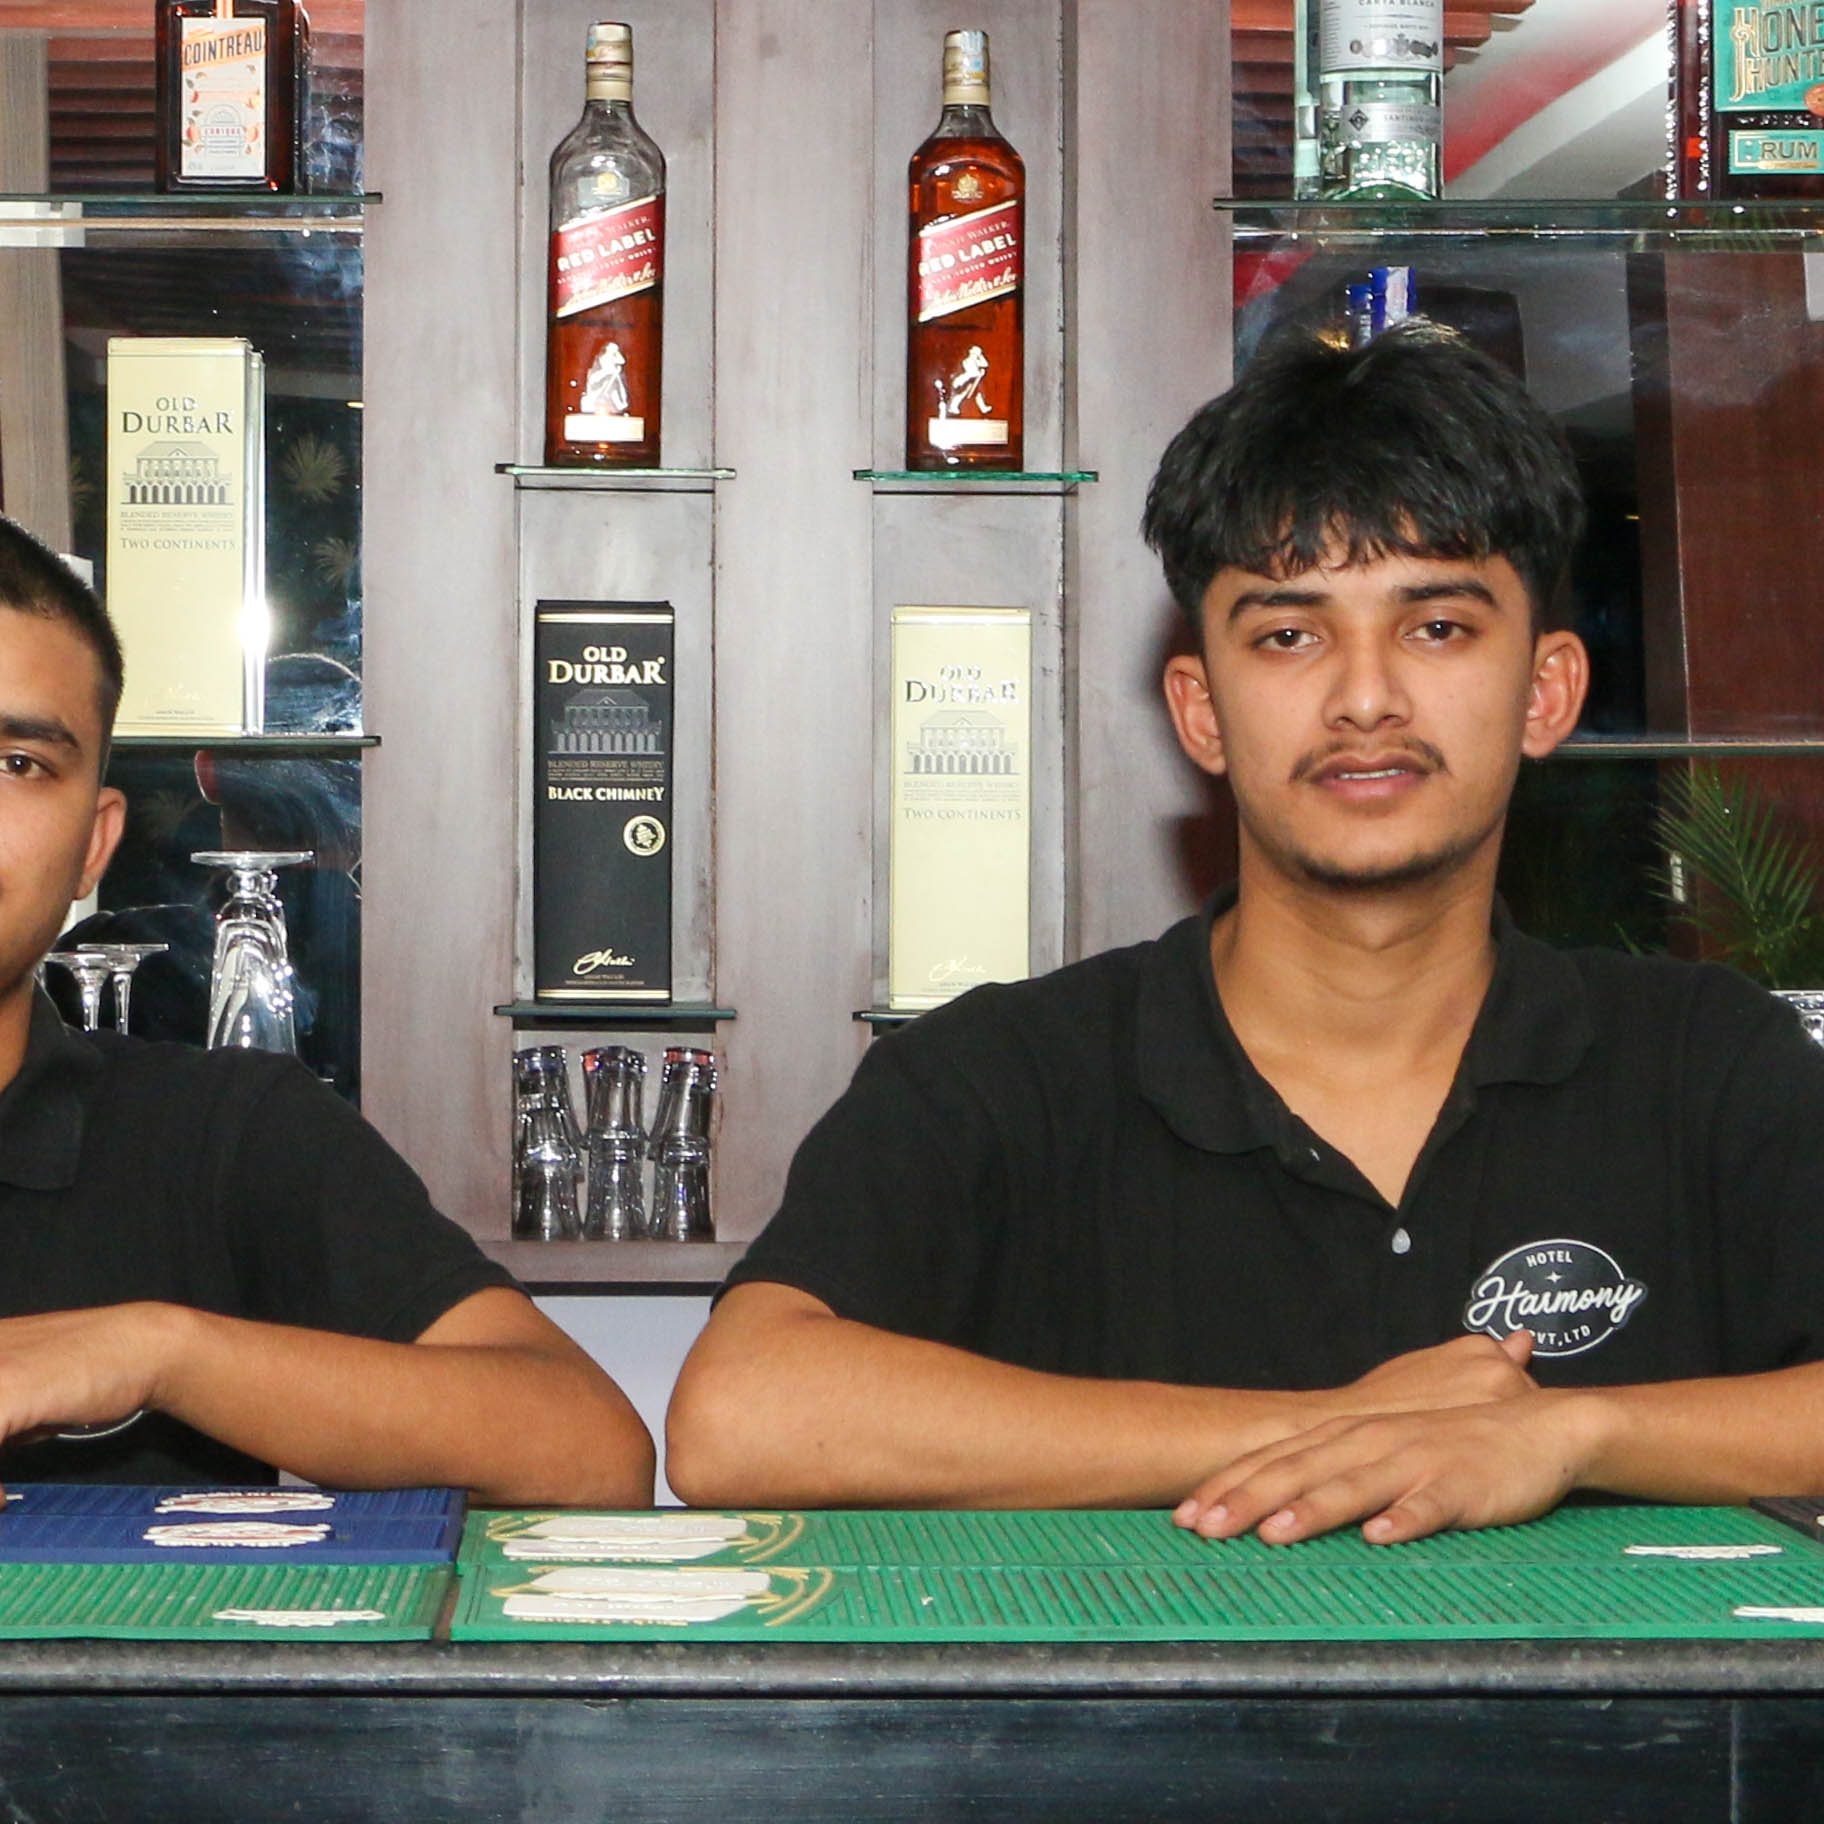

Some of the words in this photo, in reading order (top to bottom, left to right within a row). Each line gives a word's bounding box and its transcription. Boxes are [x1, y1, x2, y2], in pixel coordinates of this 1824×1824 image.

[183, 29, 264, 66] COINTREAU
[1760, 141, 1818, 159] RUM
[556, 248, 596, 272] RED
[597, 227, 657, 257] LABEL
[918, 253, 956, 277] RED
[957, 232, 1017, 263] LABEL
[155, 396, 198, 412] OLD
[121, 410, 234, 434] DURBAR
[120, 537, 151, 550] TWO
[153, 537, 236, 551] CONTINENTS
[582, 646, 628, 663] OLD
[547, 660, 667, 685] DURBAR
[547, 786, 594, 801] BLACK
[595, 786, 665, 801] CHIMNEY
[904, 807, 934, 820] TWO
[936, 807, 1022, 820] CONTINENTS
[1525, 1249, 1574, 1268] HOTEL
[1467, 1274, 1644, 1332] Harmony
